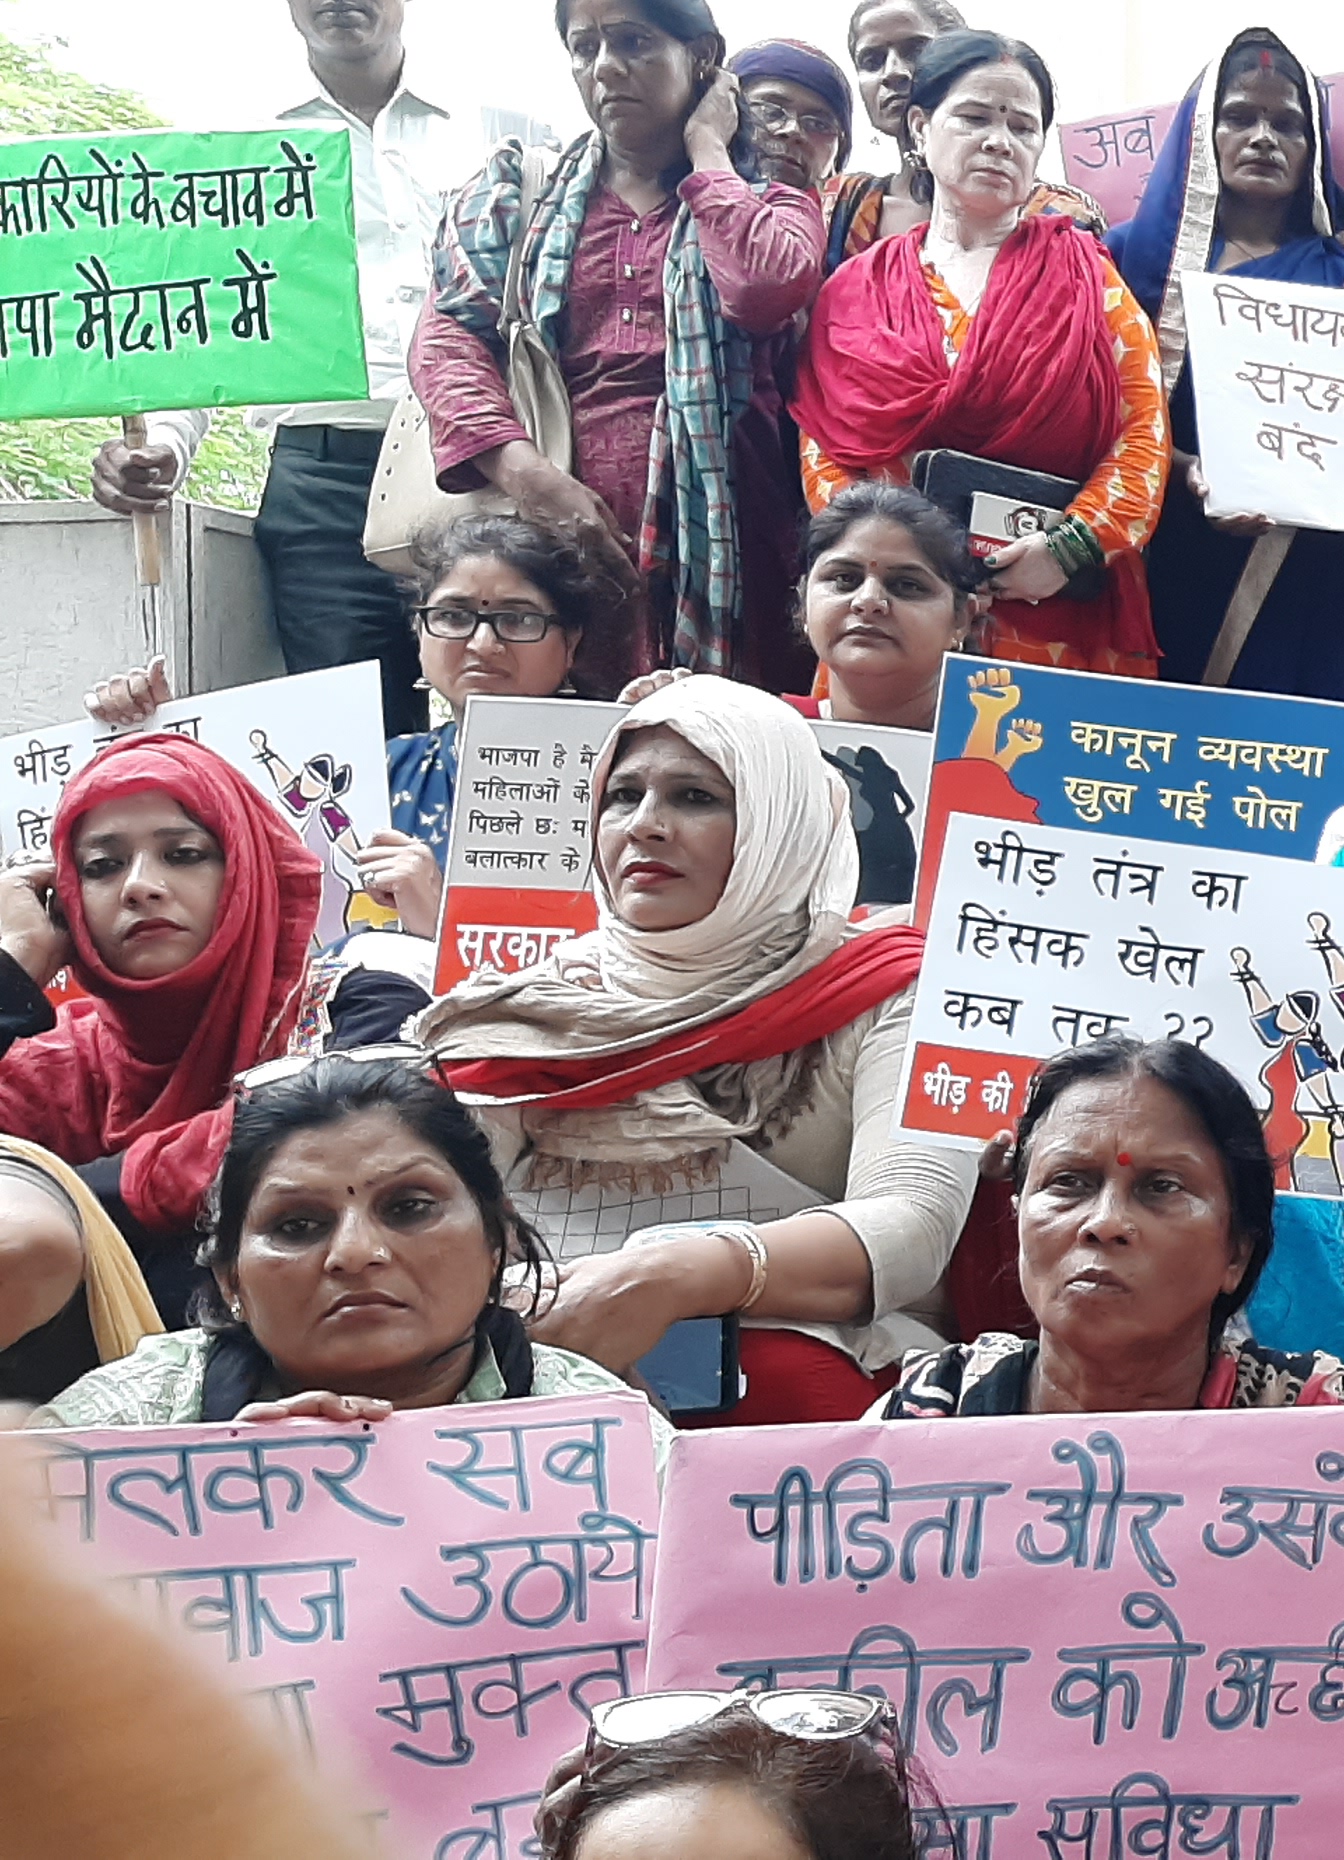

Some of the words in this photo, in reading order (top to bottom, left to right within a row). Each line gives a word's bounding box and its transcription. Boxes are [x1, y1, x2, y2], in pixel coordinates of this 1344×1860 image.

[1073, 115, 1155, 169] अब
[131, 151, 165, 231] के
[170, 165, 271, 228] बचाव
[273, 140, 317, 220] में
[74, 255, 212, 359] मैदान
[222, 248, 278, 341] में
[1256, 421, 1338, 471] बंद
[478, 746, 541, 768] भाजपा
[553, 742, 568, 769] है
[1070, 720, 1178, 774] कानून
[1197, 735, 1329, 779] व्यवस्था
[573, 778, 590, 804] के
[1061, 775, 1138, 824] खुल
[1158, 780, 1212, 829] गई
[1232, 784, 1304, 833] पोल
[467, 808, 524, 835] पिछले
[464, 850, 551, 872] बलात्कार
[559, 846, 581, 873] के
[973, 830, 1065, 897] भीड़
[1092, 848, 1165, 906] तंत्र
[1191, 867, 1249, 914] का
[955, 902, 1091, 971] हिंसक
[1117, 925, 1205, 989] खेल
[943, 988, 1024, 1039] कब
[922, 1061, 971, 1115] भीड़
[980, 1070, 1014, 1115] की
[426, 1417, 622, 1514] सब
[729, 1457, 1012, 1593] पीड़िता
[1016, 1431, 1184, 1588] और
[400, 1511, 658, 1629] उठाये
[1051, 1591, 1206, 1747] को
